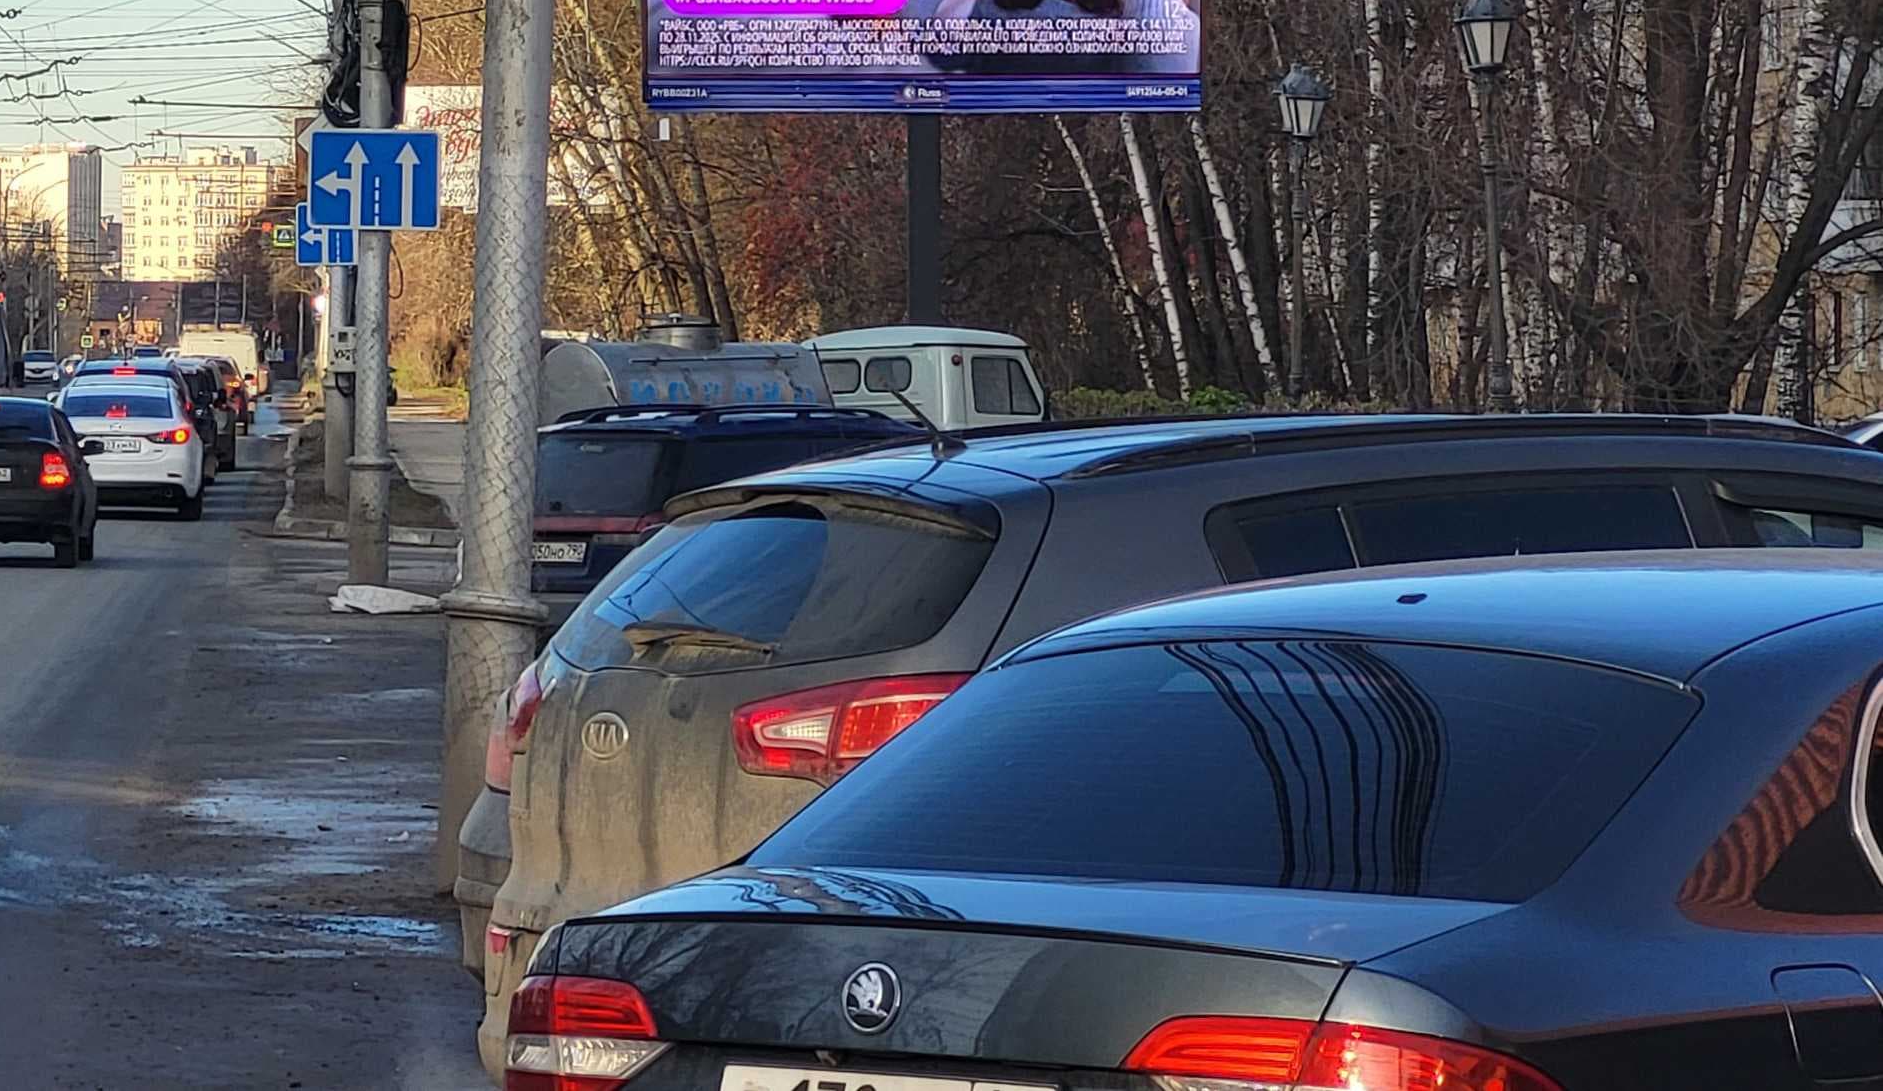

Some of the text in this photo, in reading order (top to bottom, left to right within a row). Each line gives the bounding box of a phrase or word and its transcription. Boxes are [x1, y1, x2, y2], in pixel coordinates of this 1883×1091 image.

[696, 20, 717, 31] ООО
[842, 20, 900, 31] МОСКОВСКАЯ
[1055, 19, 1079, 30] СРОК
[883, 43, 912, 55] МЕСТЕ
[917, 88, 942, 98] Russ
